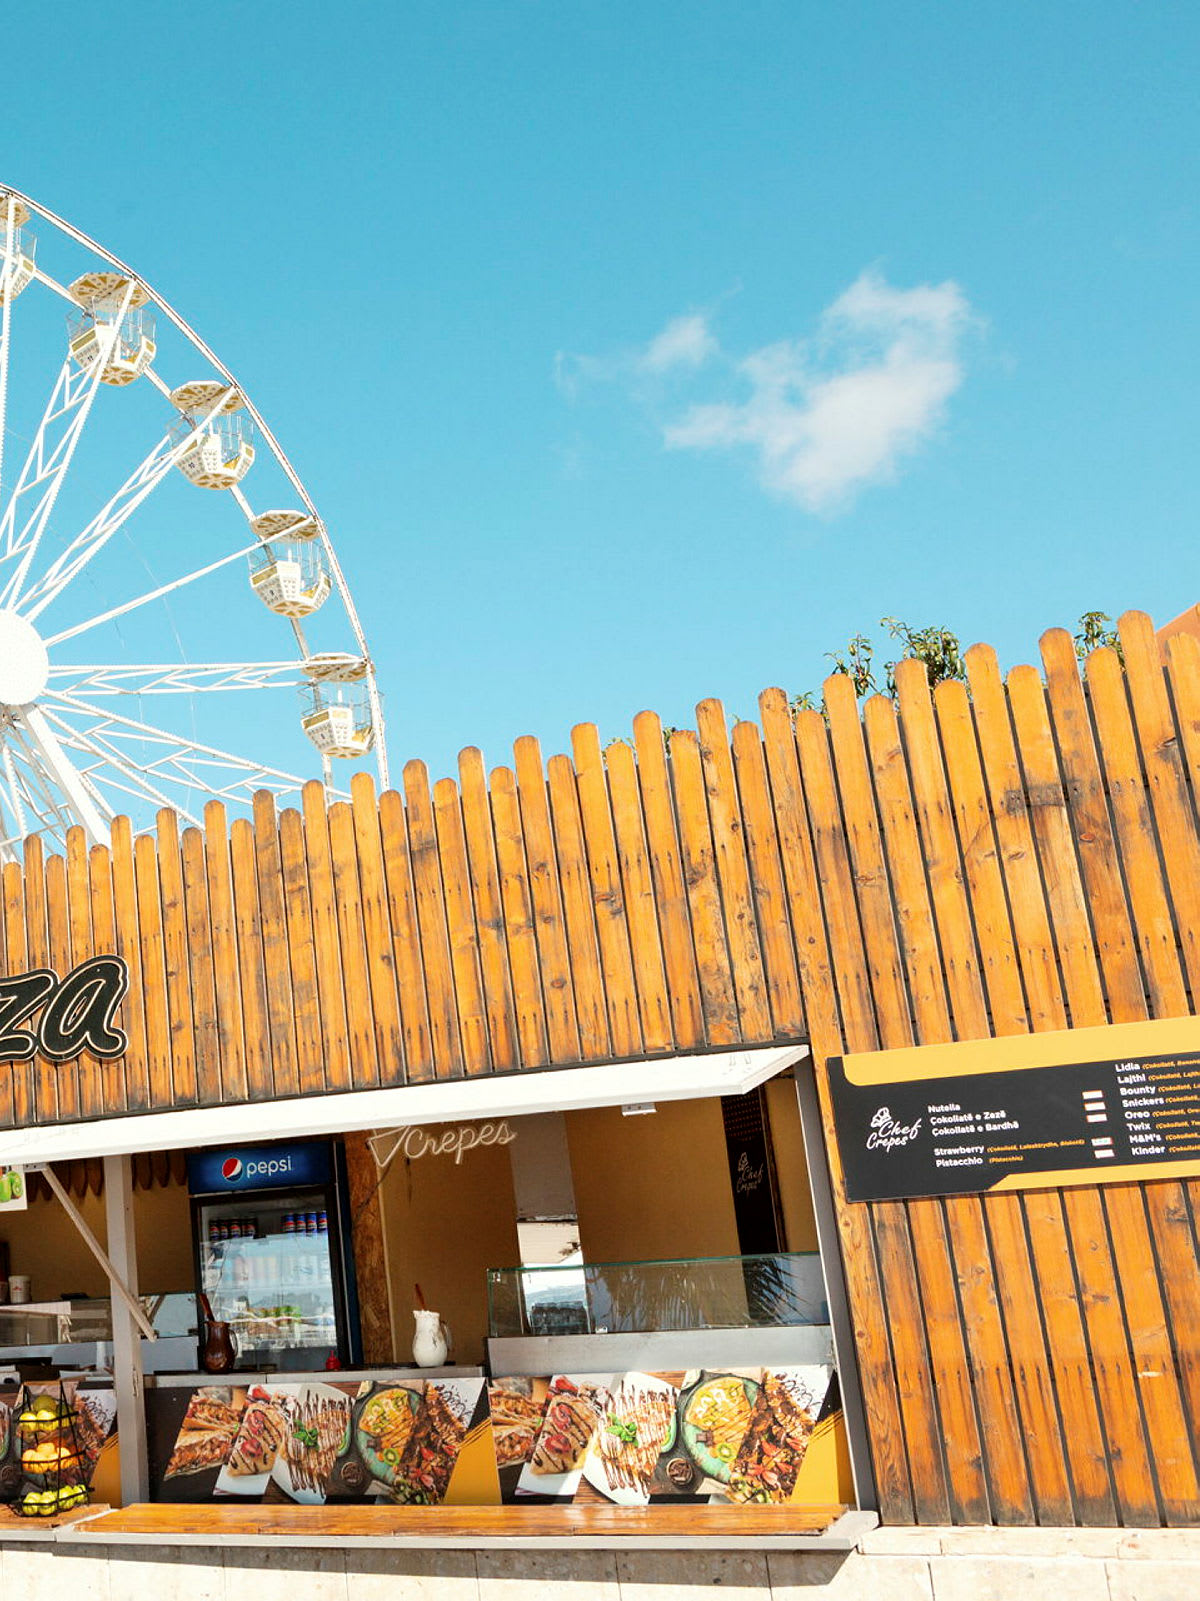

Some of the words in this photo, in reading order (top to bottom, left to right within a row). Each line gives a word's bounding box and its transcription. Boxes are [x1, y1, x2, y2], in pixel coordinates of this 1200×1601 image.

[1115, 1062, 1140, 1072] Lidia
[1117, 1073, 1146, 1084] Lajthi
[1120, 1085, 1156, 1096] Bounty
[928, 1103, 960, 1113] Nutella
[1122, 1097, 1164, 1108] Snickers
[1124, 1111, 1150, 1119] Oreo
[879, 1118, 922, 1140] Chef
[1126, 1122, 1151, 1131] Twix
[405, 1121, 517, 1164] Crepes
[866, 1132, 908, 1152] Crepes
[1129, 1133, 1161, 1144] M&M's
[934, 1145, 984, 1156] Strawberry
[1131, 1145, 1165, 1156] Kinder
[246, 1155, 292, 1178] pepsi
[936, 1157, 983, 1167] Pistacchio
